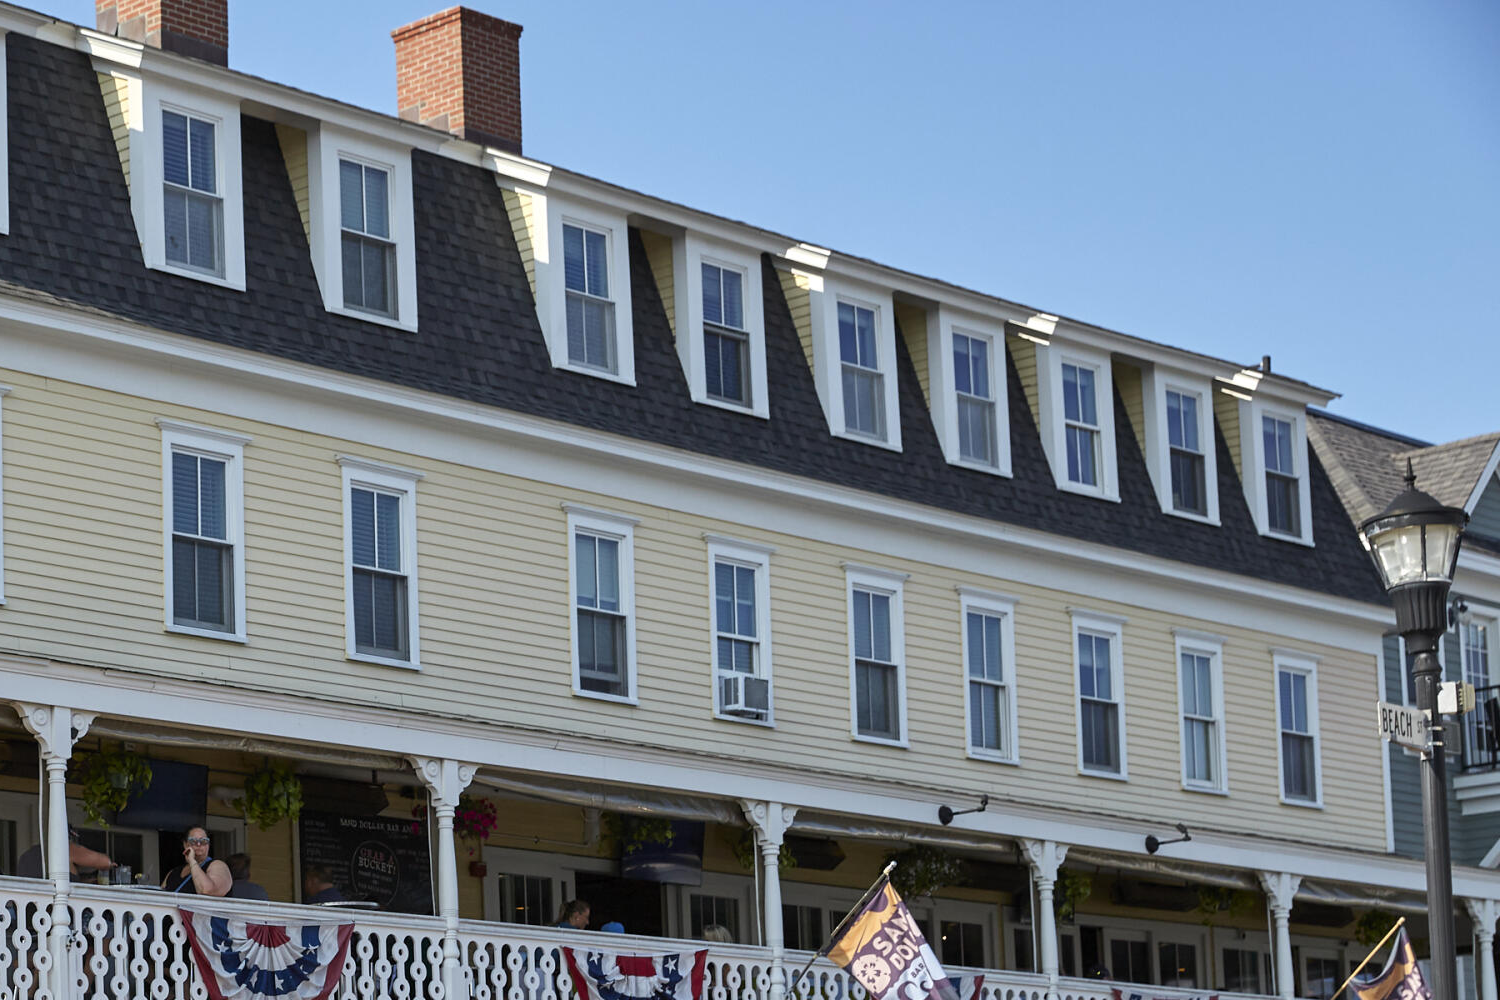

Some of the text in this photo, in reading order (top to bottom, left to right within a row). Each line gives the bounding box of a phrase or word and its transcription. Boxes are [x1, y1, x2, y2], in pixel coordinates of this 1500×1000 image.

[1383, 708, 1412, 738] BEACH
[873, 907, 910, 957] SAN
[889, 932, 920, 971] DOL
